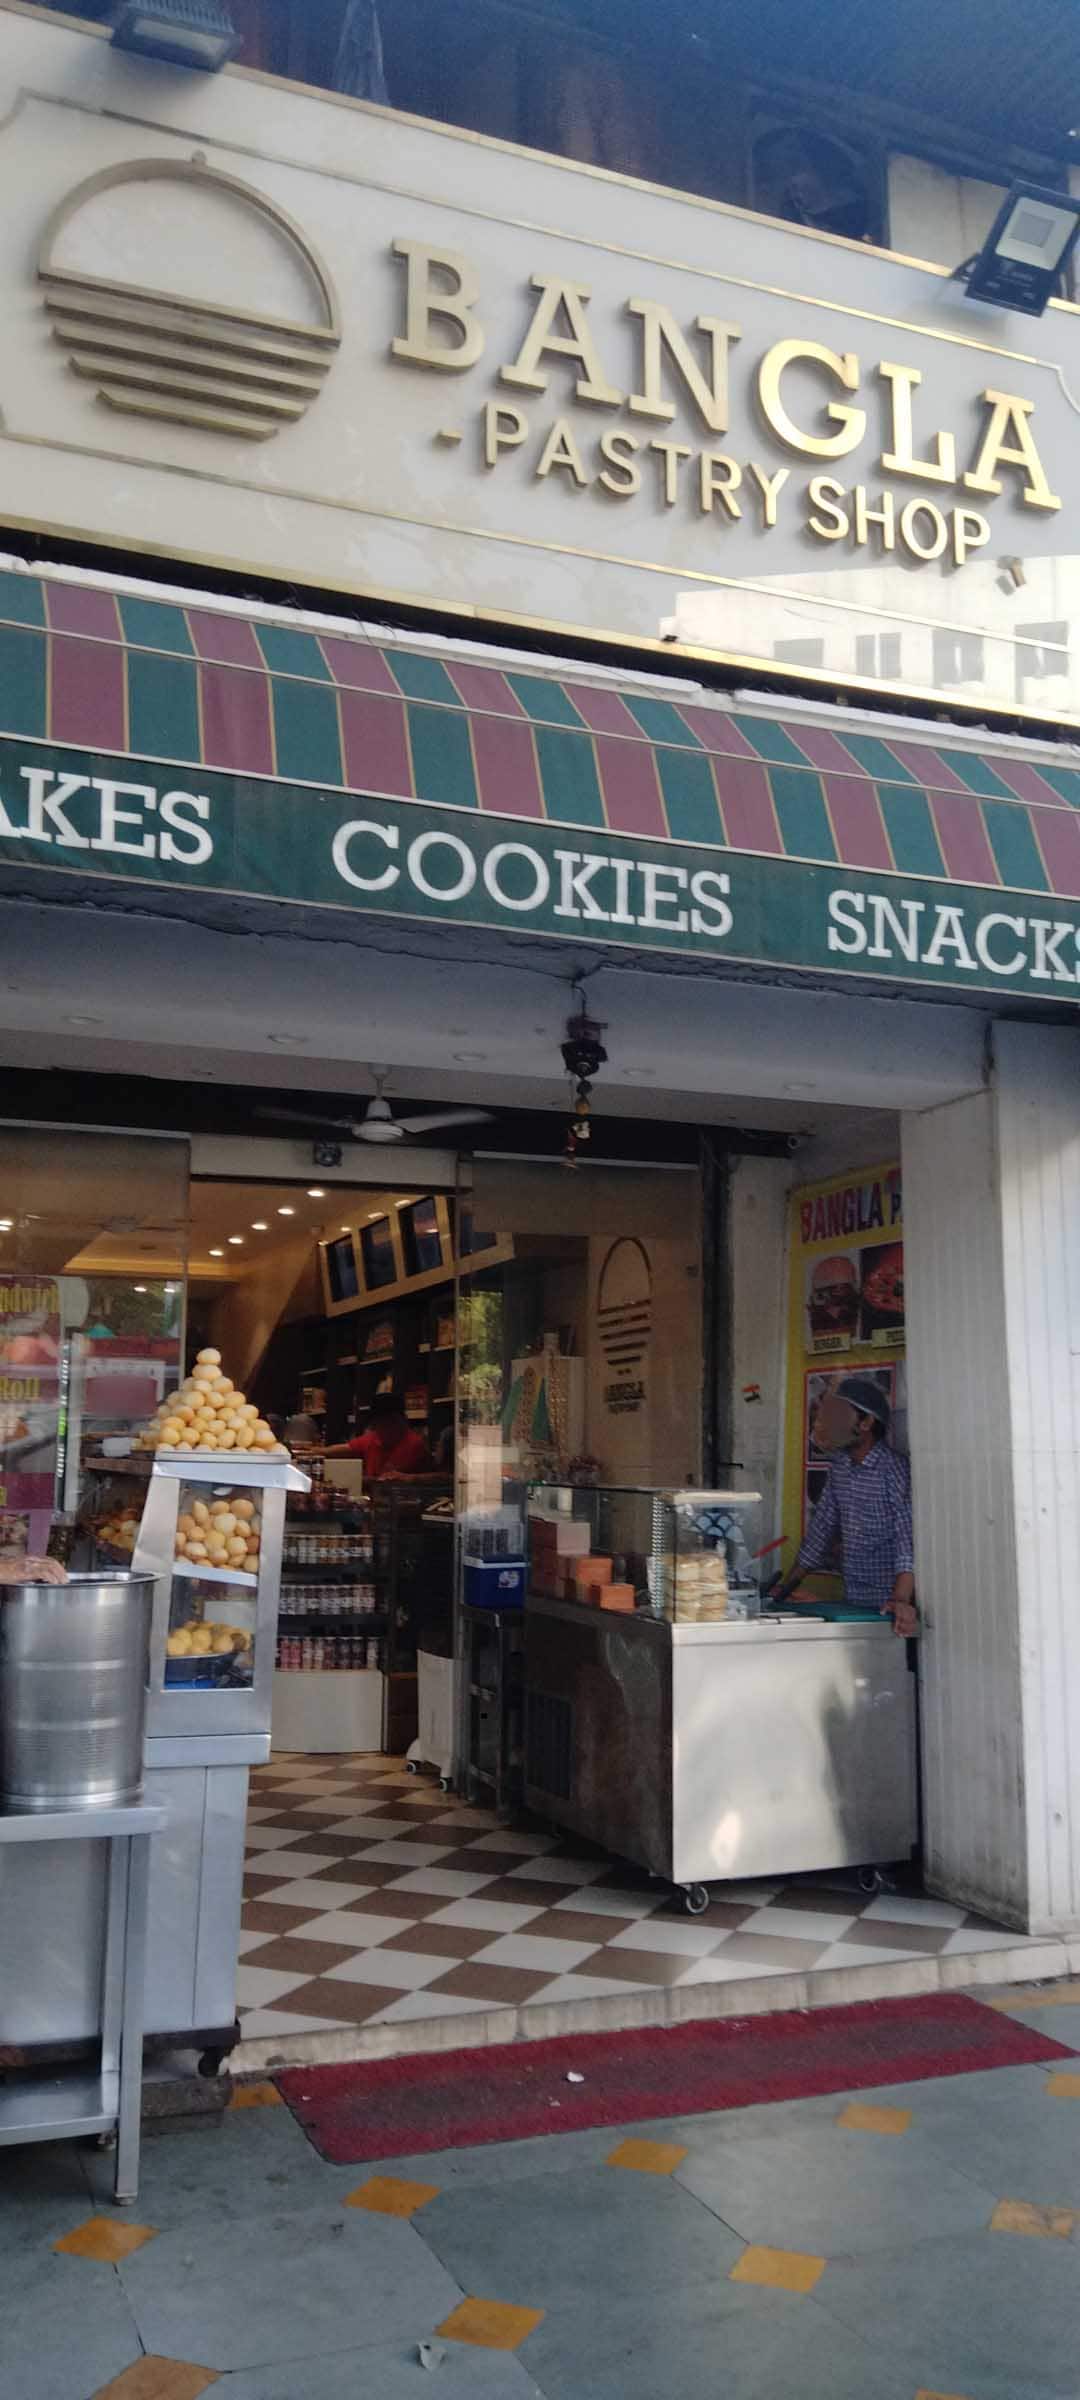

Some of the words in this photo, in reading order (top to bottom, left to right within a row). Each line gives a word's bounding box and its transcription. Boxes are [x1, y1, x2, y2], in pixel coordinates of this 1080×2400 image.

[389, 237, 1062, 512] BANGLA
[482, 402, 790, 528] PASTRY
[807, 474, 991, 568] SHOP
[331, 820, 734, 936] COOKIES
[828, 889, 1080, 982] SNACK
[800, 1181, 885, 1244] BANGLA
[890, 1192, 904, 1225] P
